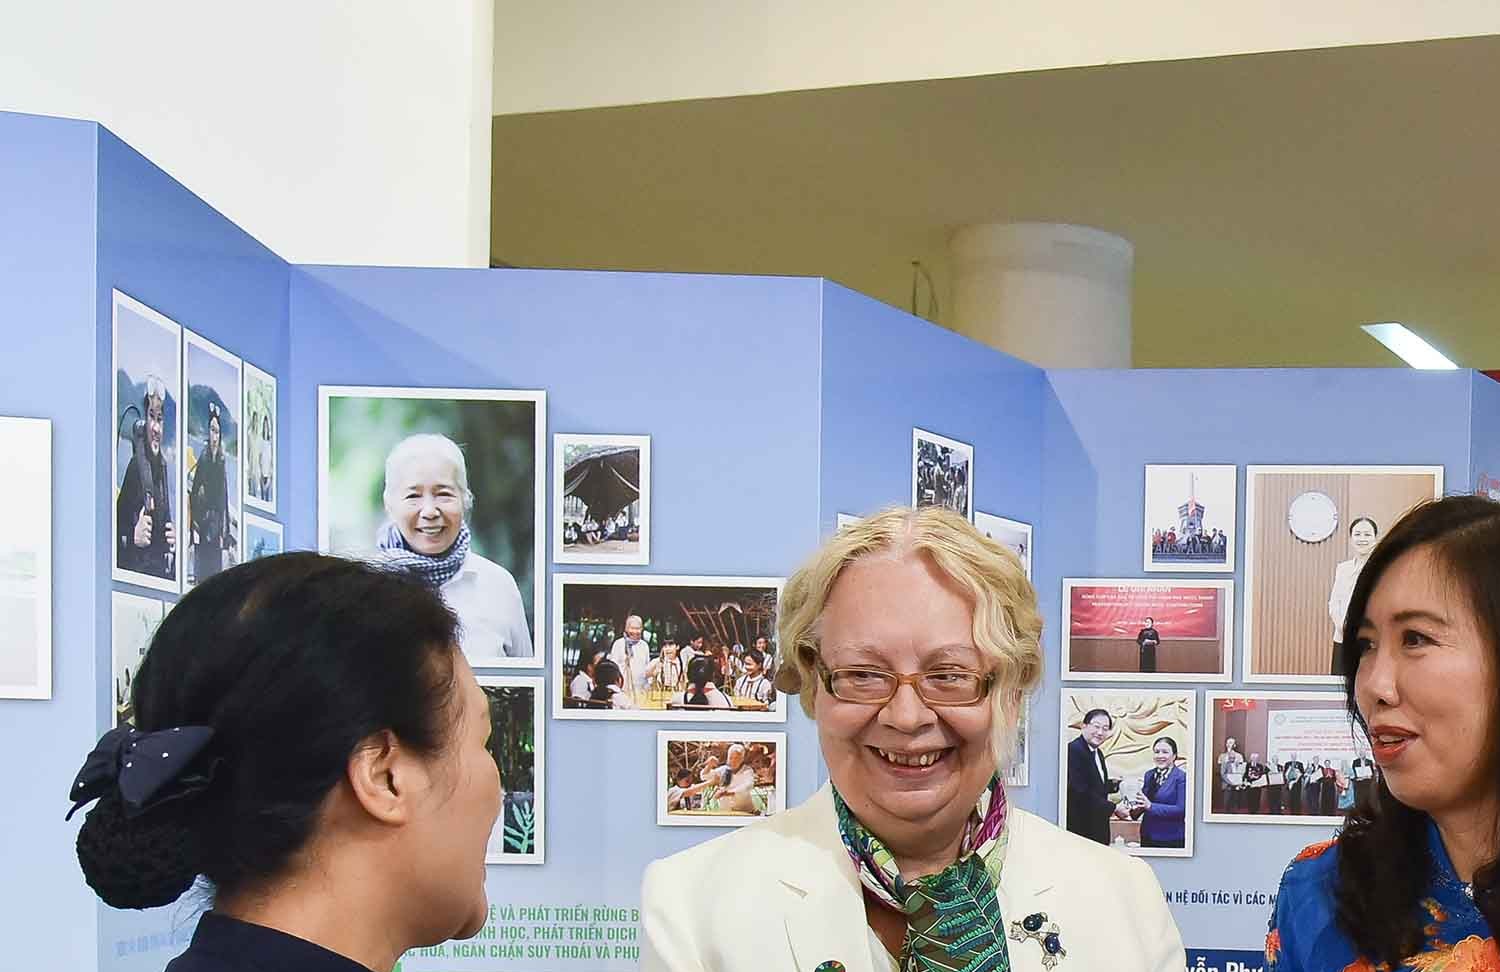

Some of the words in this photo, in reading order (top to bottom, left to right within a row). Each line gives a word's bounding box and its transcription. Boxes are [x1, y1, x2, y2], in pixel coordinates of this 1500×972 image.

[1176, 890, 1188, 905] HỆ
[1190, 889, 1209, 904] ĐỐI
[1211, 892, 1230, 905] TÁC
[1232, 890, 1243, 904] VÌ
[1245, 891, 1266, 906] CÁC
[501, 905, 516, 922] VÀ
[519, 904, 551, 922] PHÁT
[503, 926, 530, 942] HỌC,
[533, 922, 565, 940] PHÁT
[607, 926, 637, 943] DỊCH
[527, 945, 552, 960] SUY
[555, 942, 592, 960] THOÁI
[595, 942, 611, 960] VÀ
